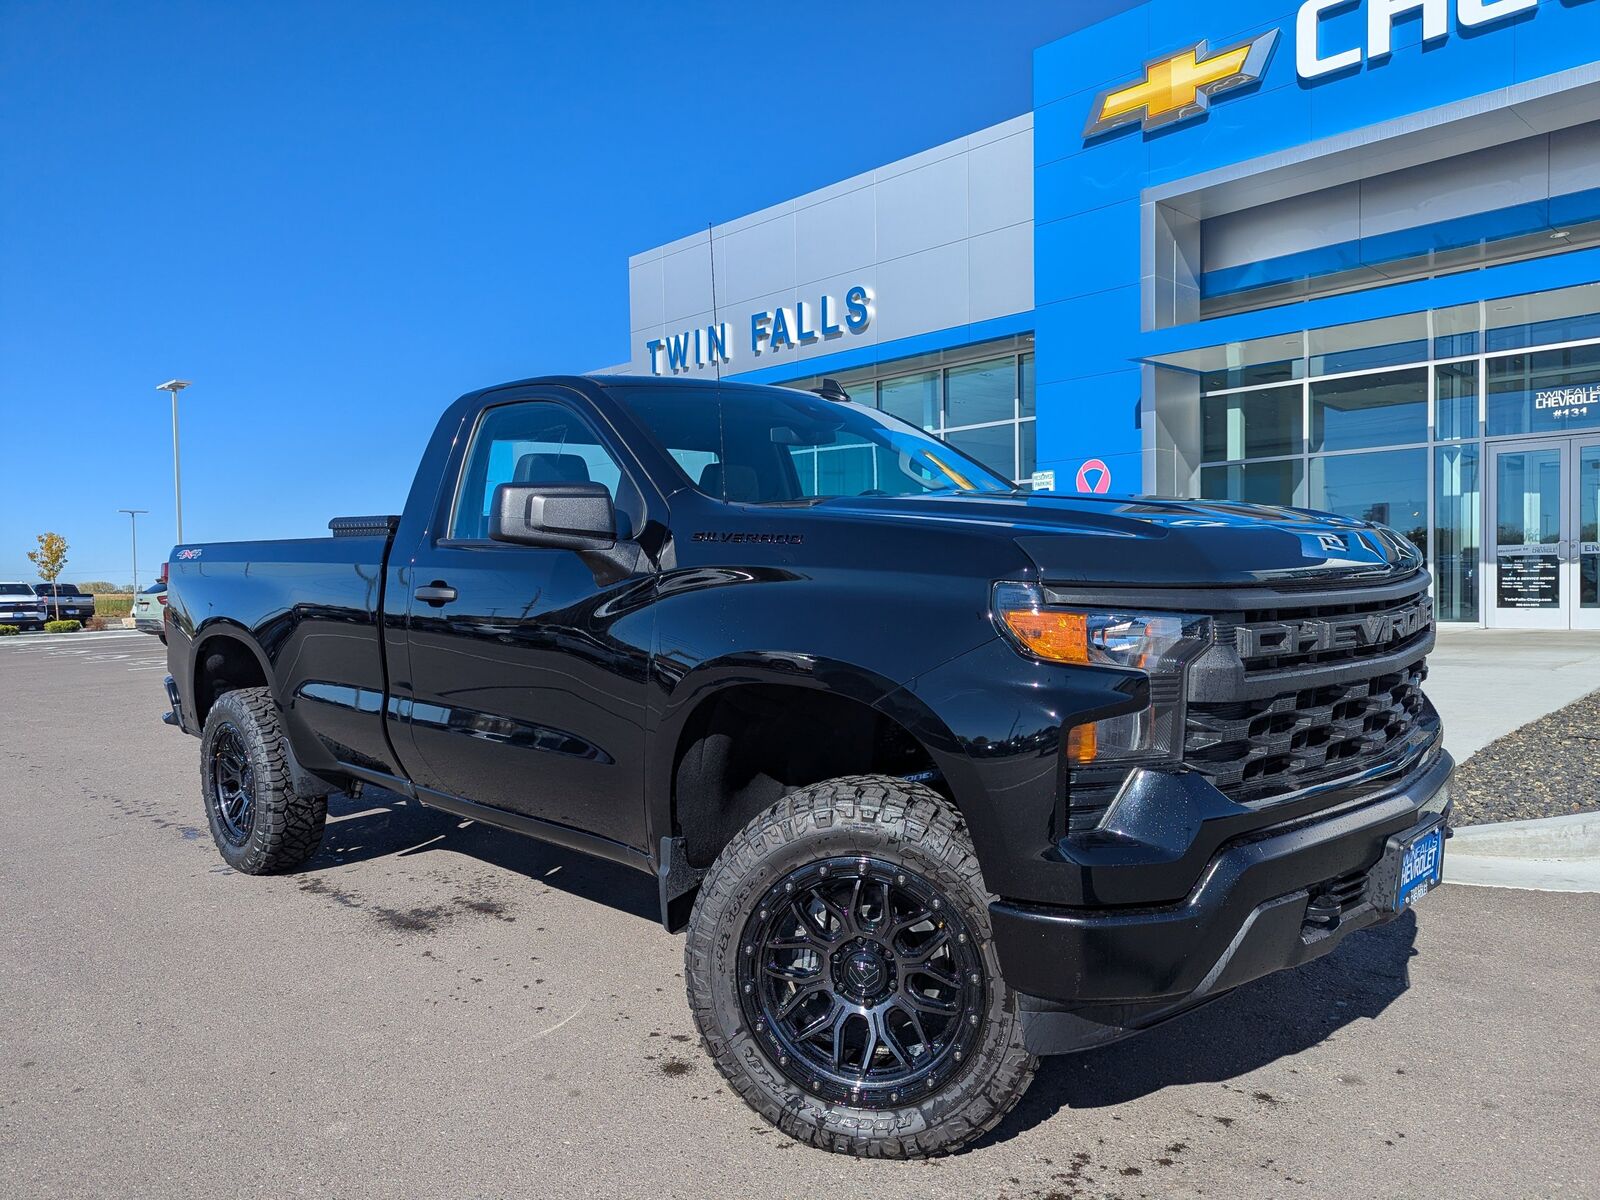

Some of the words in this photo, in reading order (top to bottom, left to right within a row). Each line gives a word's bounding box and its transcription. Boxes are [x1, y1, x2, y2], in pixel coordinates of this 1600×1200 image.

[1296, 0, 1538, 80] CH
[646, 322, 730, 376] TWIN
[751, 286, 874, 356] FALLS
[1552, 406, 1588, 419] #131
[692, 532, 804, 544] SILVERADO
[1401, 847, 1437, 888] HEVROLET
